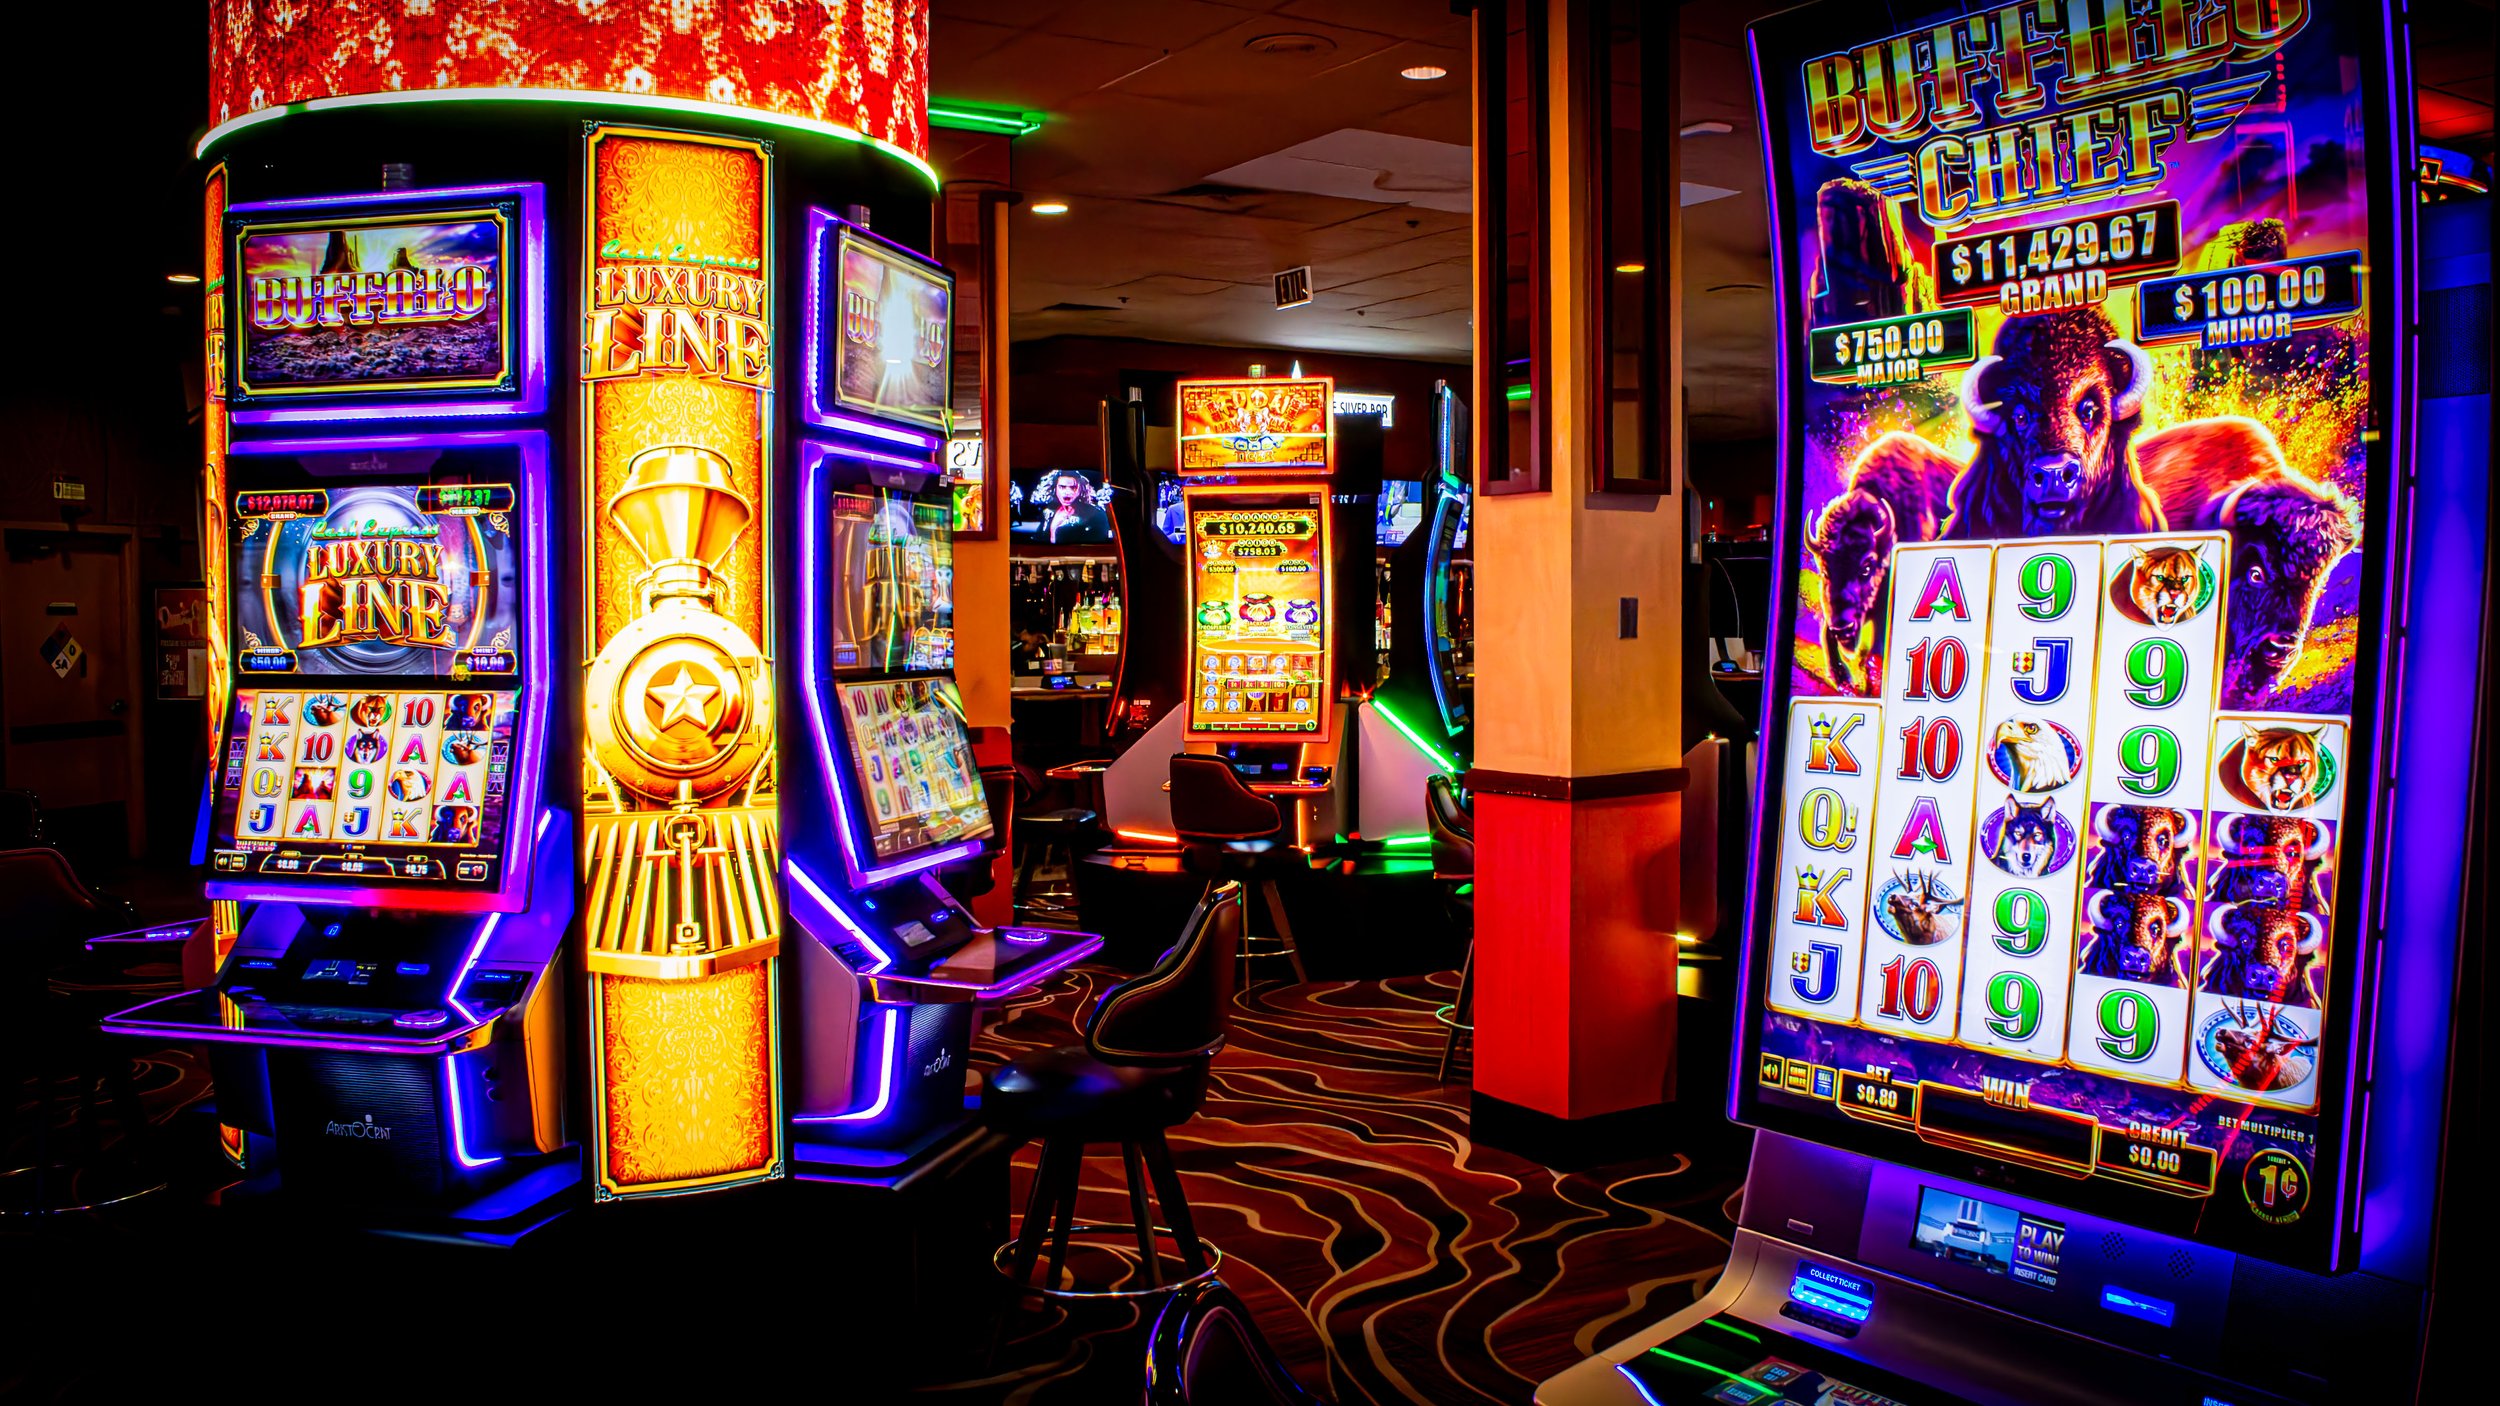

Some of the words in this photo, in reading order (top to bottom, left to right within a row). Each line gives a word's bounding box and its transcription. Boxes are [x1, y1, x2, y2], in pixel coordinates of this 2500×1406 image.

[1919, 89, 2185, 230] CHIEF
[601, 239, 661, 260] Cash
[667, 244, 760, 268] Express
[1951, 212, 2158, 285] $11,429.67
[252, 264, 490, 330] BUFFALO
[595, 266, 766, 318] LUXURY
[2000, 270, 2108, 316] GRAND
[2175, 265, 2326, 322] $100.00
[1835, 319, 1945, 363] $750.00
[2206, 313, 2294, 348] MINOR
[581, 306, 774, 392] LINE
[1856, 358, 1924, 387] MAJOR
[312, 520, 356, 538] Cash
[362, 519, 439, 541] Express
[1219, 522, 1295, 535] $10,240.68
[1232, 513, 1279, 522] GRAND
[307, 541, 444, 581] LUXURY
[1238, 547, 1276, 556] $758.03
[1909, 557, 1972, 622] A
[2017, 552, 2077, 621] 9
[298, 579, 457, 649] LINE
[251, 656, 287, 670] $50.00
[465, 656, 505, 671] $10.00
[1903, 635, 1970, 702] 10
[2010, 636, 2073, 705] J
[2124, 636, 2189, 710] 9
[261, 696, 294, 726] K
[402, 697, 435, 727] 10
[852, 689, 868, 717] 10
[873, 687, 889, 716] 10
[256, 732, 289, 762] K
[302, 732, 334, 762] 10
[398, 734, 429, 764] A
[1805, 713, 1865, 776] K
[1897, 715, 1964, 783] 10
[2117, 724, 2182, 798] 9
[252, 768, 282, 797] Q
[348, 768, 374, 799] 9
[443, 771, 474, 802] A
[249, 803, 277, 834] J
[292, 805, 322, 836] A
[342, 807, 371, 836] J
[388, 808, 422, 837] K
[1798, 786, 1856, 853] Q
[1889, 795, 1953, 864] A
[1792, 867, 1853, 931] K
[1991, 887, 2050, 958] 9
[1790, 940, 1843, 1005] J
[1877, 954, 1944, 1025] 10
[1985, 970, 2043, 1042] 9
[2095, 988, 2160, 1063] 9
[1866, 1064, 1891, 1084] BET
[1856, 1083, 1898, 1110] $0.80
[1982, 1075, 2030, 1109] WIN
[2129, 1121, 2189, 1148] CREDIT
[2218, 1115, 2238, 1129] BET
[2239, 1118, 2305, 1143] MULTIPLIER
[2128, 1144, 2181, 1174] $0.00
[2017, 1245, 2032, 1261] TO
[2033, 1248, 2060, 1266] WIN!
[2018, 1224, 2065, 1253] PLAY
[1810, 1268, 1839, 1284] COLLECT
[1838, 1277, 1861, 1291] TICKET
[2013, 1266, 2037, 1281] INSERT
[2037, 1273, 2057, 1287] CARD
